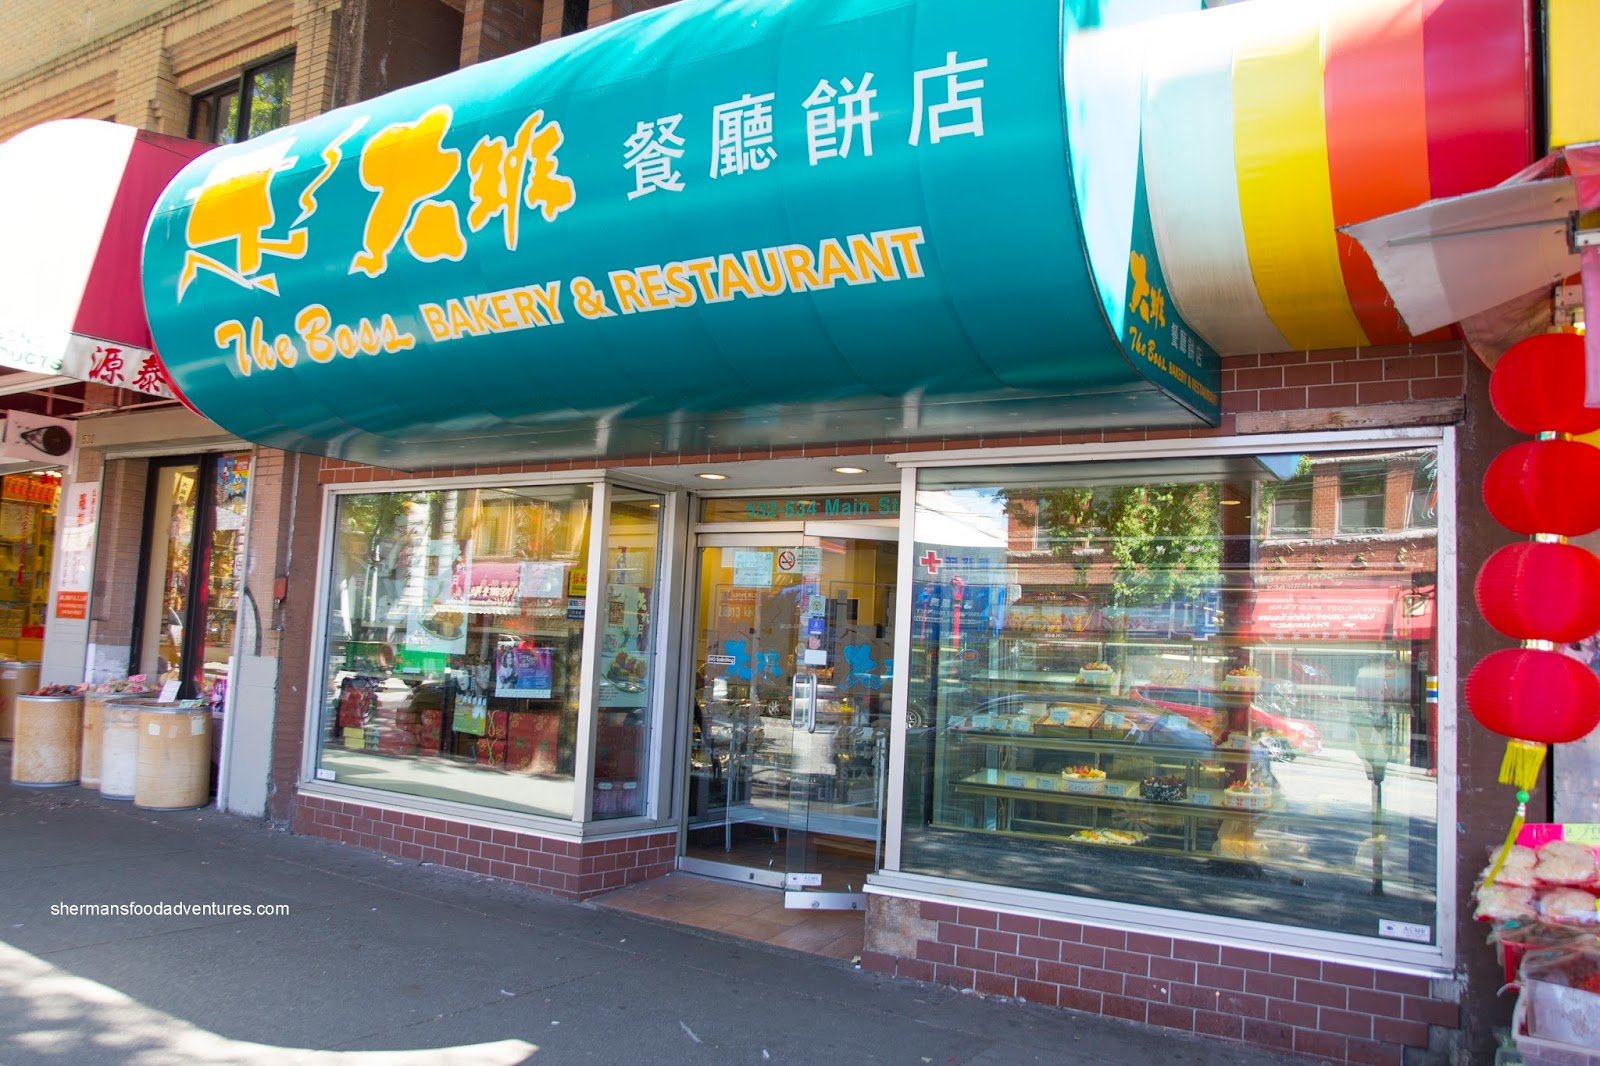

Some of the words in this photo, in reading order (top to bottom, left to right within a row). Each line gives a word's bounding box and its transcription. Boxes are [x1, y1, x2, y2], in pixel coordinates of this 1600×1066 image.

[622, 51, 989, 200] 餐廳餅店
[214, 317, 297, 377] The
[294, 303, 416, 363] Boss
[419, 280, 564, 343] BAKERY
[570, 274, 610, 323] &
[607, 226, 925, 315] RESTAURANT
[1129, 326, 1147, 356] The
[1168, 361, 1187, 385] BAKERY
[746, 500, 817, 518] 532-534
[825, 498, 869, 515] Main
